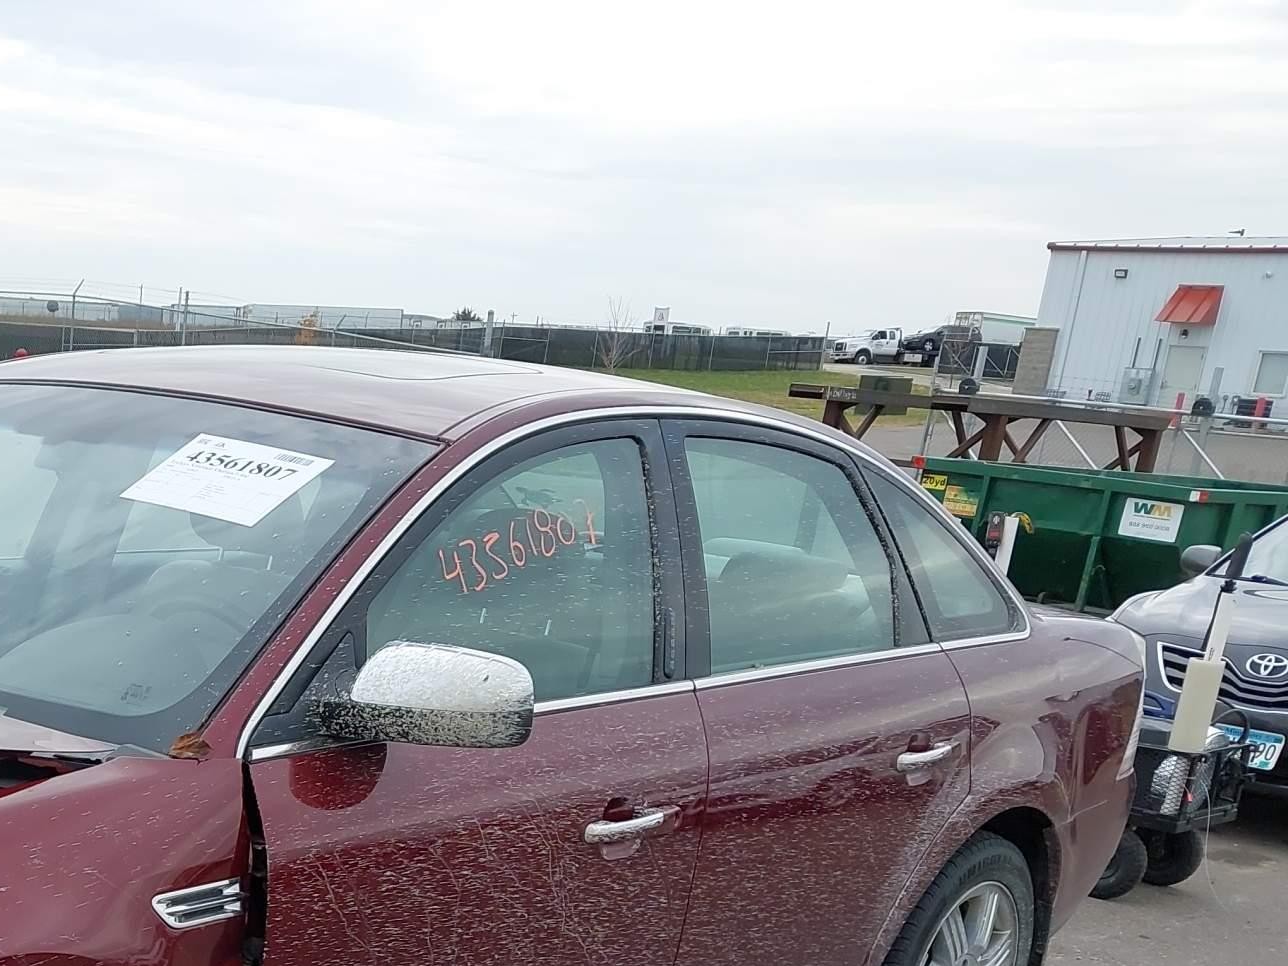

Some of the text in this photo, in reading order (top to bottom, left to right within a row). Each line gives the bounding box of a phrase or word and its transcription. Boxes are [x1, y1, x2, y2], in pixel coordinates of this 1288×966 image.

[186, 450, 299, 481] 43561807
[923, 475, 946, 487] 20yd
[1134, 502, 1172, 518] WM
[438, 498, 598, 594] 43561807
